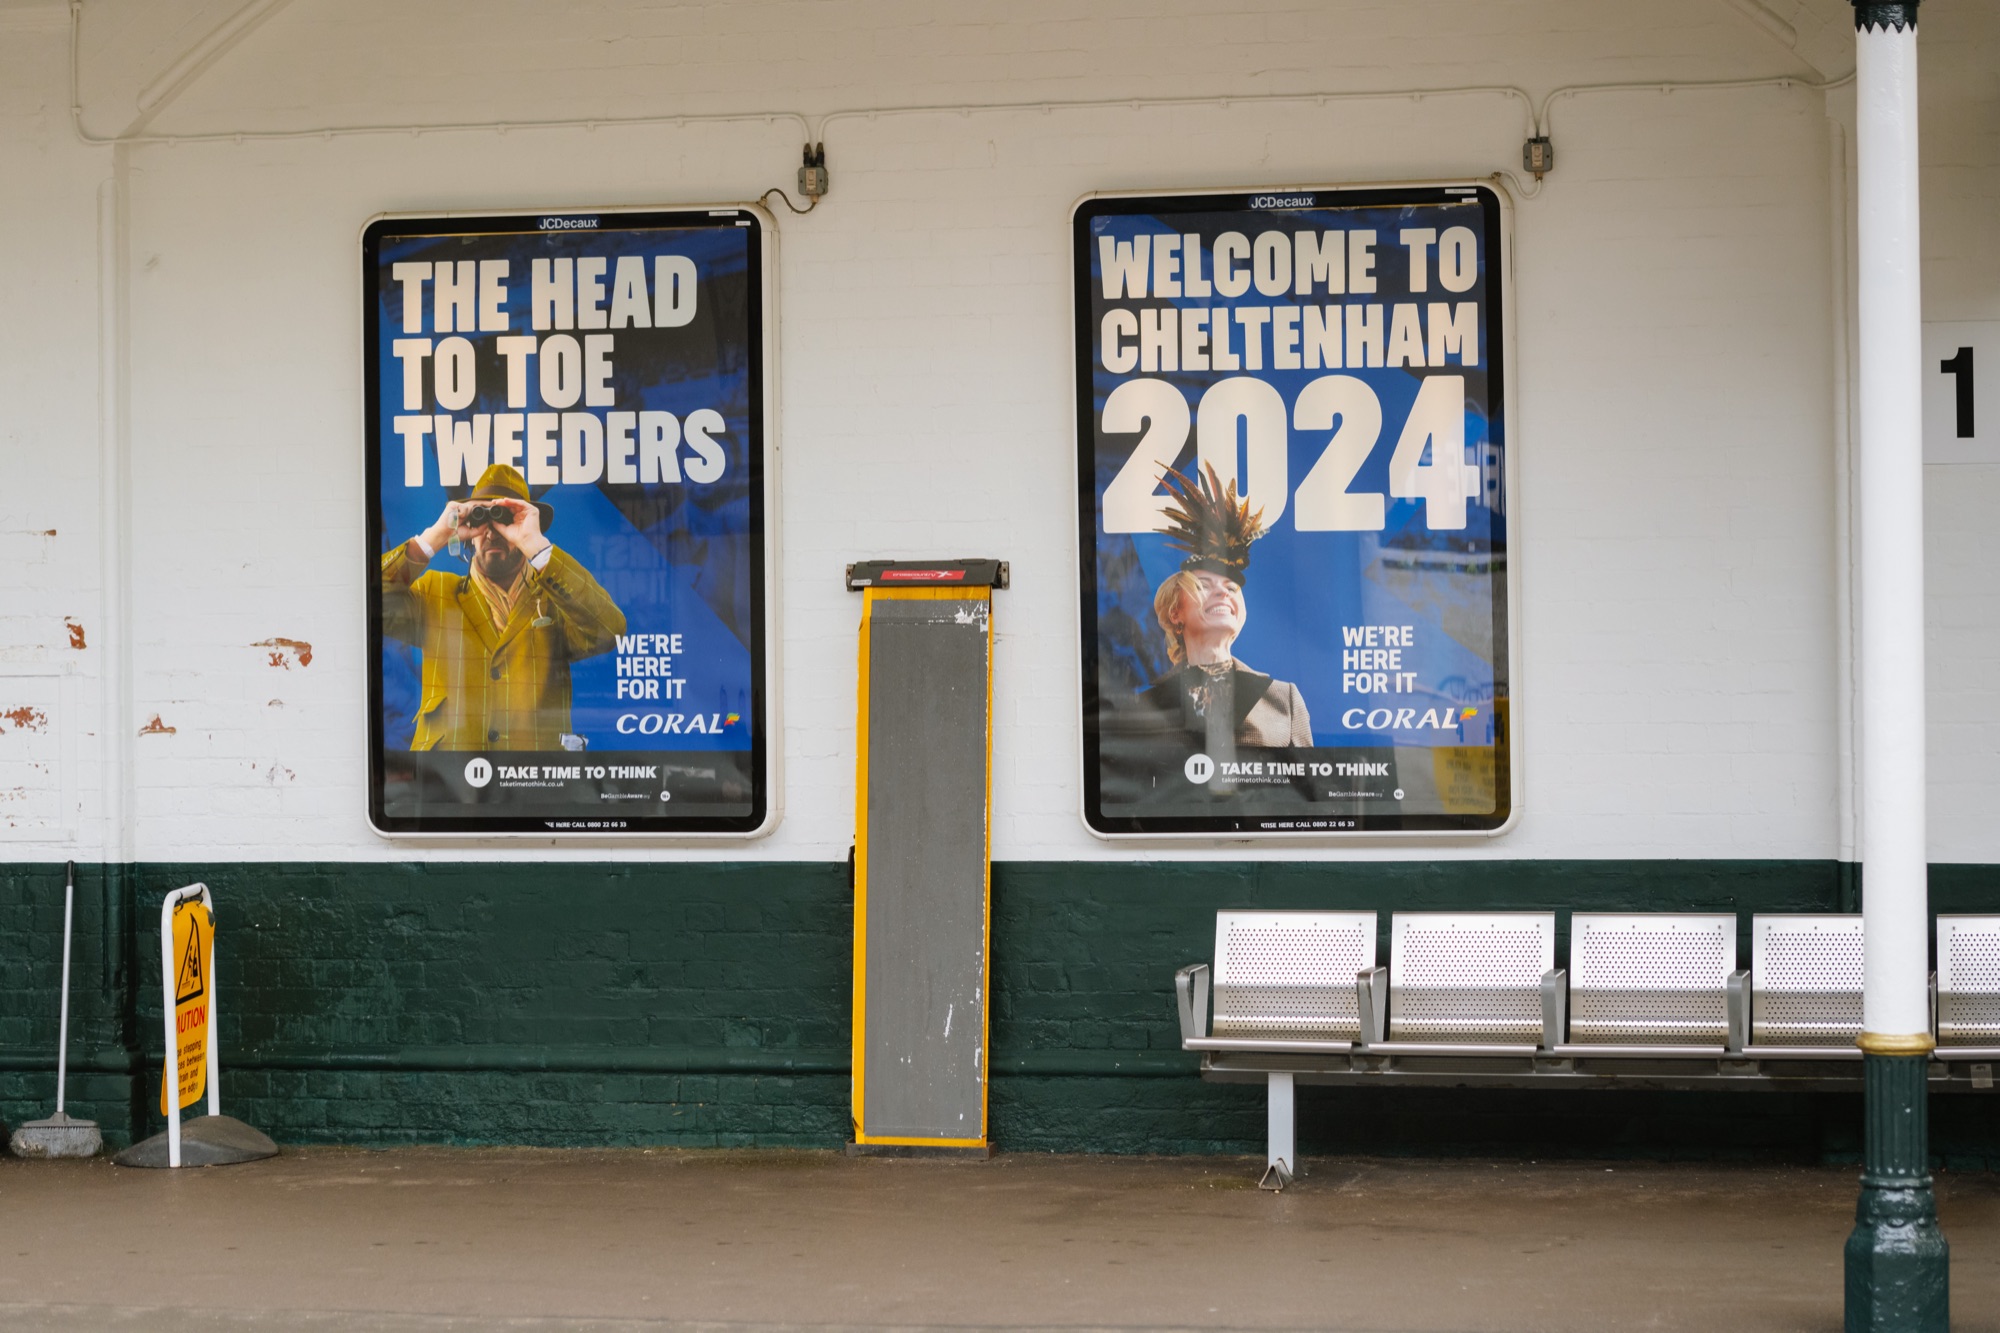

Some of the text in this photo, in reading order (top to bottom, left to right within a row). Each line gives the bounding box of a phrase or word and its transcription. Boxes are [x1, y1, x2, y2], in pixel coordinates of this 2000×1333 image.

[1250, 196, 1314, 209] JCDecaux
[539, 217, 598, 230] JCDecaux
[1098, 226, 1478, 299] WELCOME TO
[392, 255, 698, 334] THE HEAD
[1100, 302, 1479, 374] CHELTENHAM
[392, 334, 615, 411] TO TOE
[1941, 346, 1974, 438] 1
[393, 408, 727, 487] TWEEDERS
[1101, 374, 1481, 534] 2024
[614, 633, 683, 655] WE'RE
[1342, 625, 1414, 647] WE'RE
[616, 656, 672, 677] HERE
[1342, 649, 1402, 671] HERE
[617, 678, 686, 699] FOR IT
[1342, 672, 1417, 694] FOR IT
[615, 713, 724, 735] CORAL
[1341, 707, 1459, 730] CORAL
[497, 766, 657, 779] TAKE TIME TO THINK
[1220, 762, 1389, 777] TAKE TIME TO THINK
[499, 780, 564, 788] taketimetothink.co.uk
[1221, 777, 1291, 785] taketimetothink.co.uk
[177, 1005, 205, 1034] AUTION
